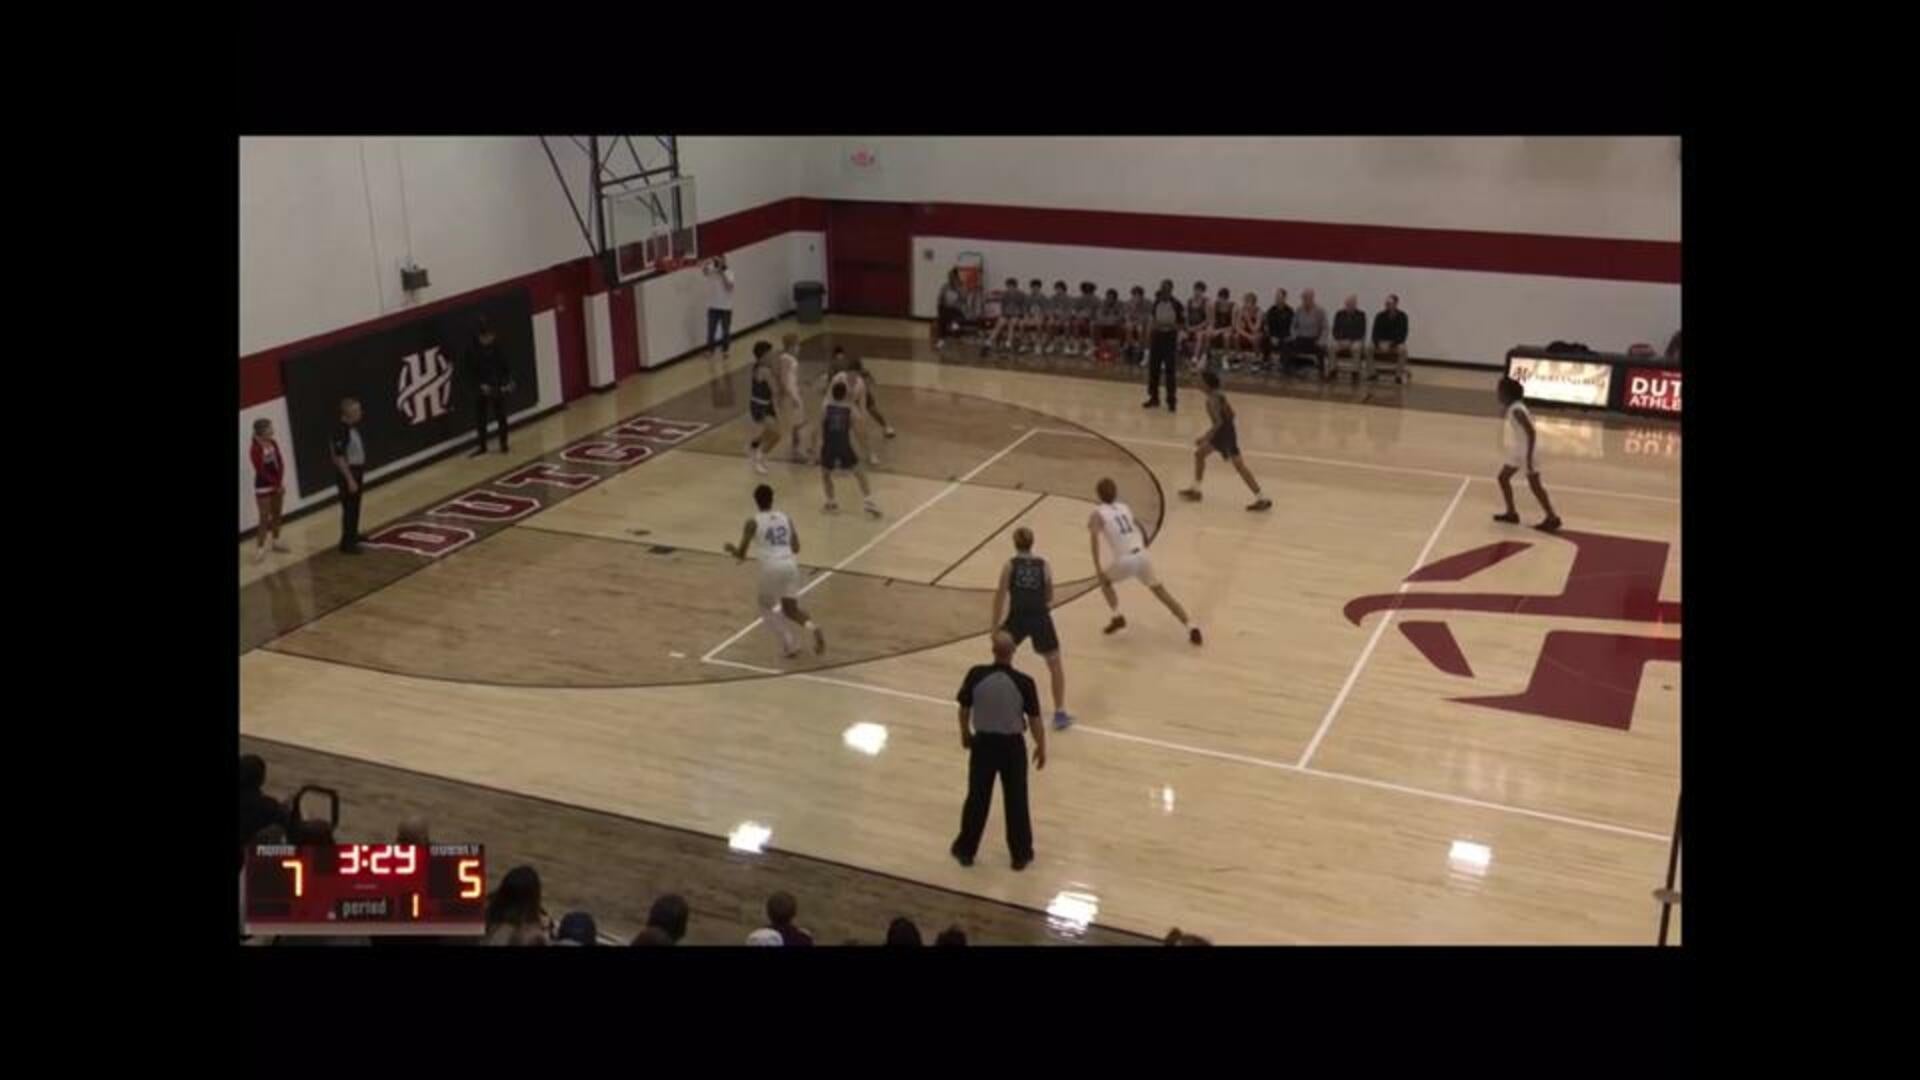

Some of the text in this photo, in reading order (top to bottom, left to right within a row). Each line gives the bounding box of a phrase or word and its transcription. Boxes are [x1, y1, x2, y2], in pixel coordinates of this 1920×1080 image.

[1631, 377, 1682, 398] DUT
[364, 417, 709, 557] DUTCH
[1114, 514, 1133, 534] 11
[765, 526, 788, 546] 42
